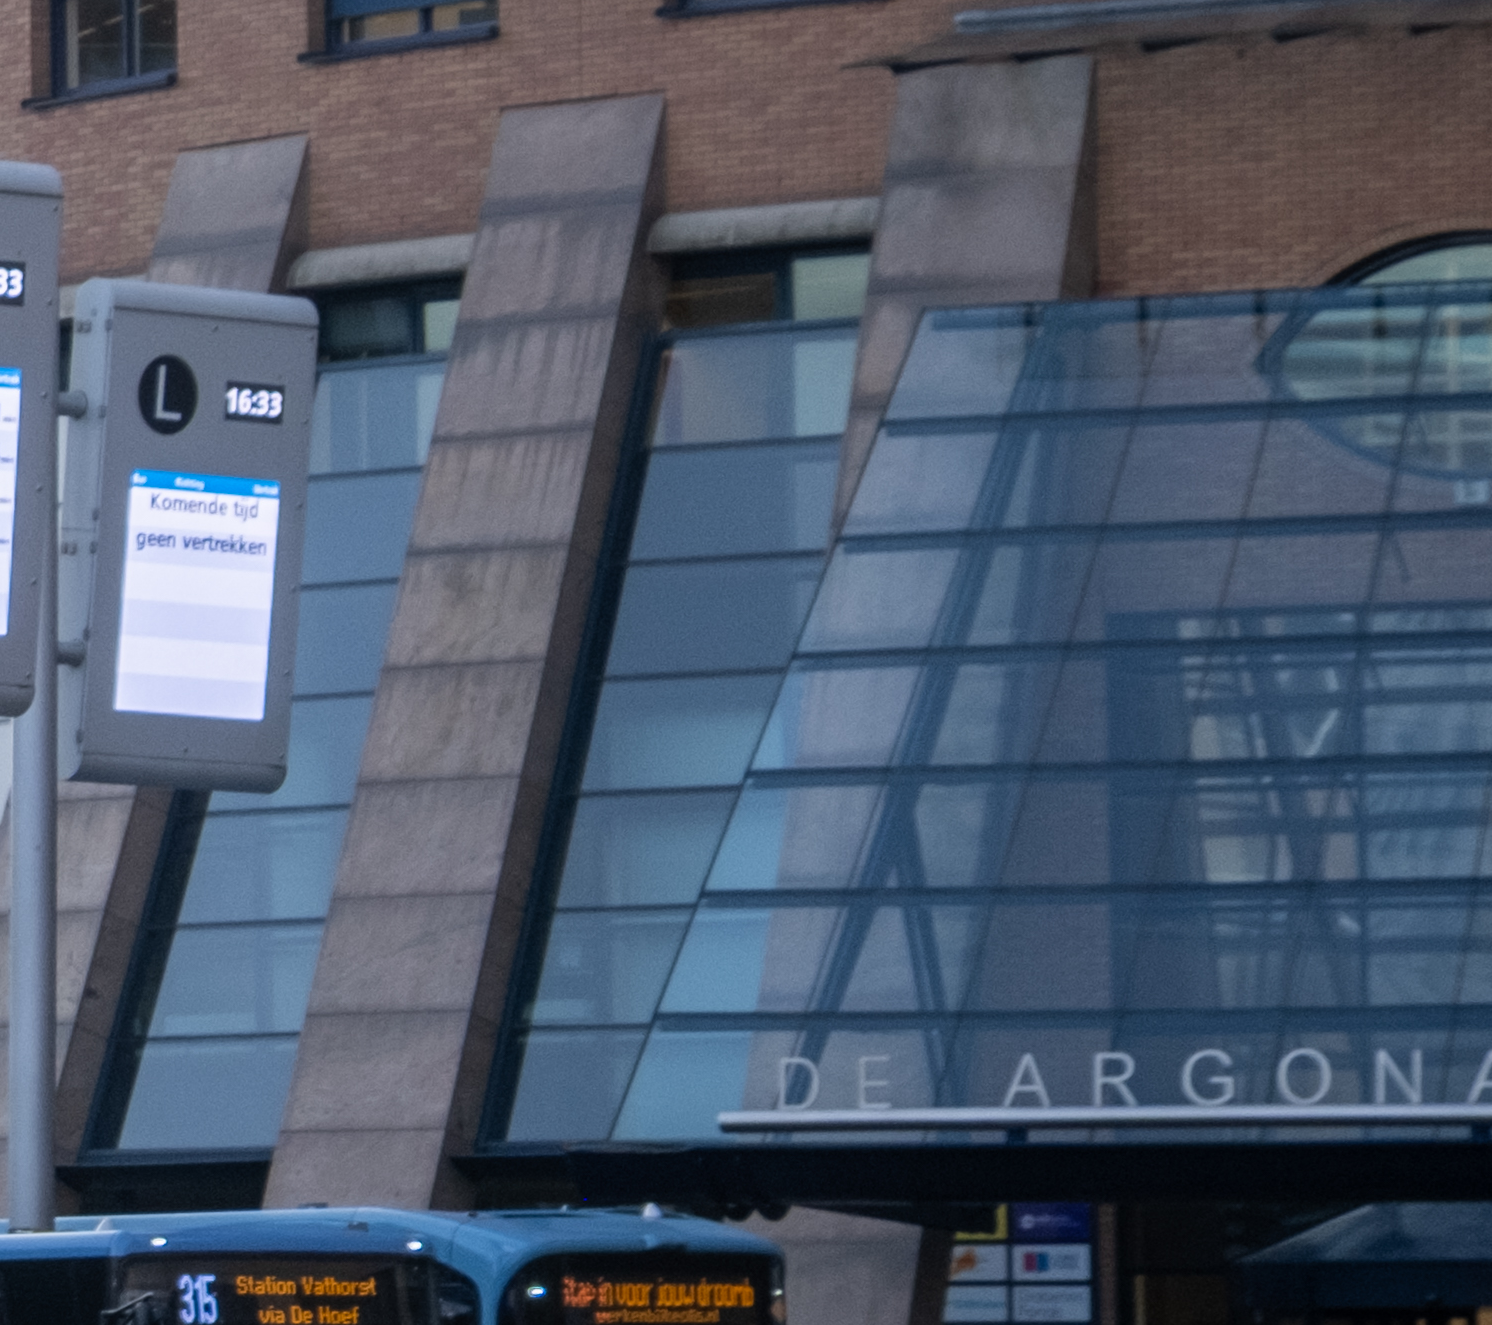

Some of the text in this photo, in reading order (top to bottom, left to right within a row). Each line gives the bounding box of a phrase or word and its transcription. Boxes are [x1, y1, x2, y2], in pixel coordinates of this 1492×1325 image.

[155, 364, 182, 421] L
[226, 387, 283, 418] 16:33
[150, 493, 258, 522] Komende tijd
[136, 532, 266, 555] geen vertrekken
[777, 1056, 892, 1110] DE
[177, 1275, 377, 1325] 315 Station Vathorst
[258, 1307, 359, 1325] via De Hoef
